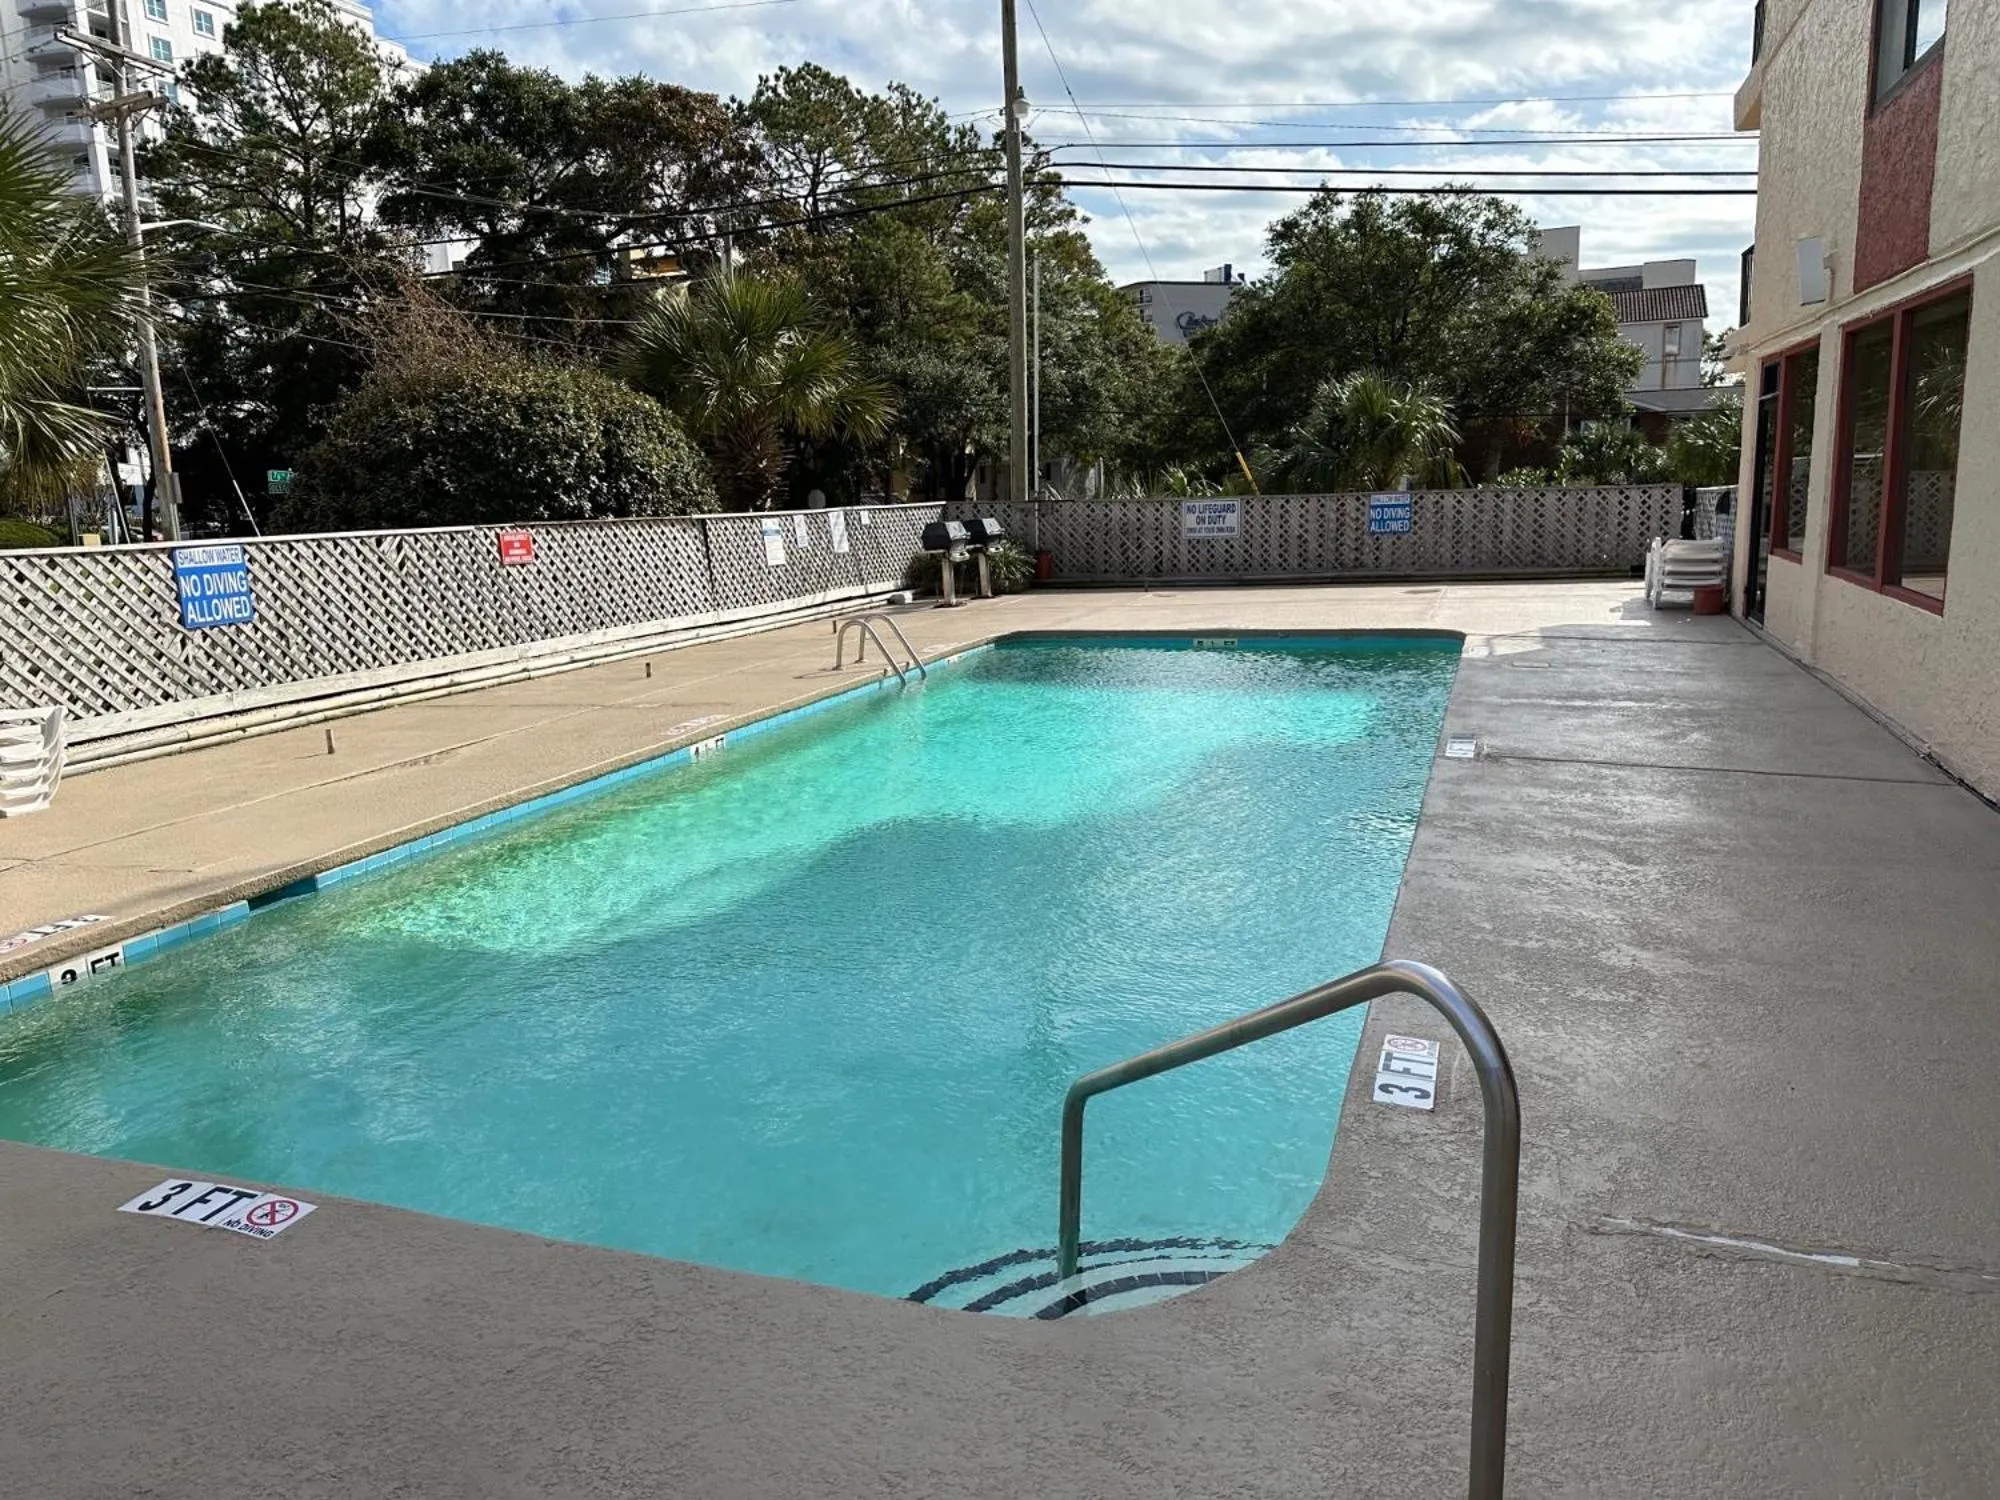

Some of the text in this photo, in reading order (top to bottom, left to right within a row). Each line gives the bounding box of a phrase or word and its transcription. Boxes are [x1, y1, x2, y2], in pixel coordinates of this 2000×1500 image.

[1186, 503, 1236, 515] NO LIFEGUARD
[1370, 506, 1410, 520] NO DIVING
[1195, 514, 1226, 525] ON DUTY
[1370, 519, 1410, 532] ALLOWED
[178, 546, 241, 566] SHALLOW WATER
[180, 571, 247, 597] NO DIVING
[188, 596, 250, 624] ALLOWED
[1378, 1052, 1434, 1100] 3 FT
[138, 1182, 259, 1222] 3 FT
[223, 1218, 274, 1238] NO DIVING
